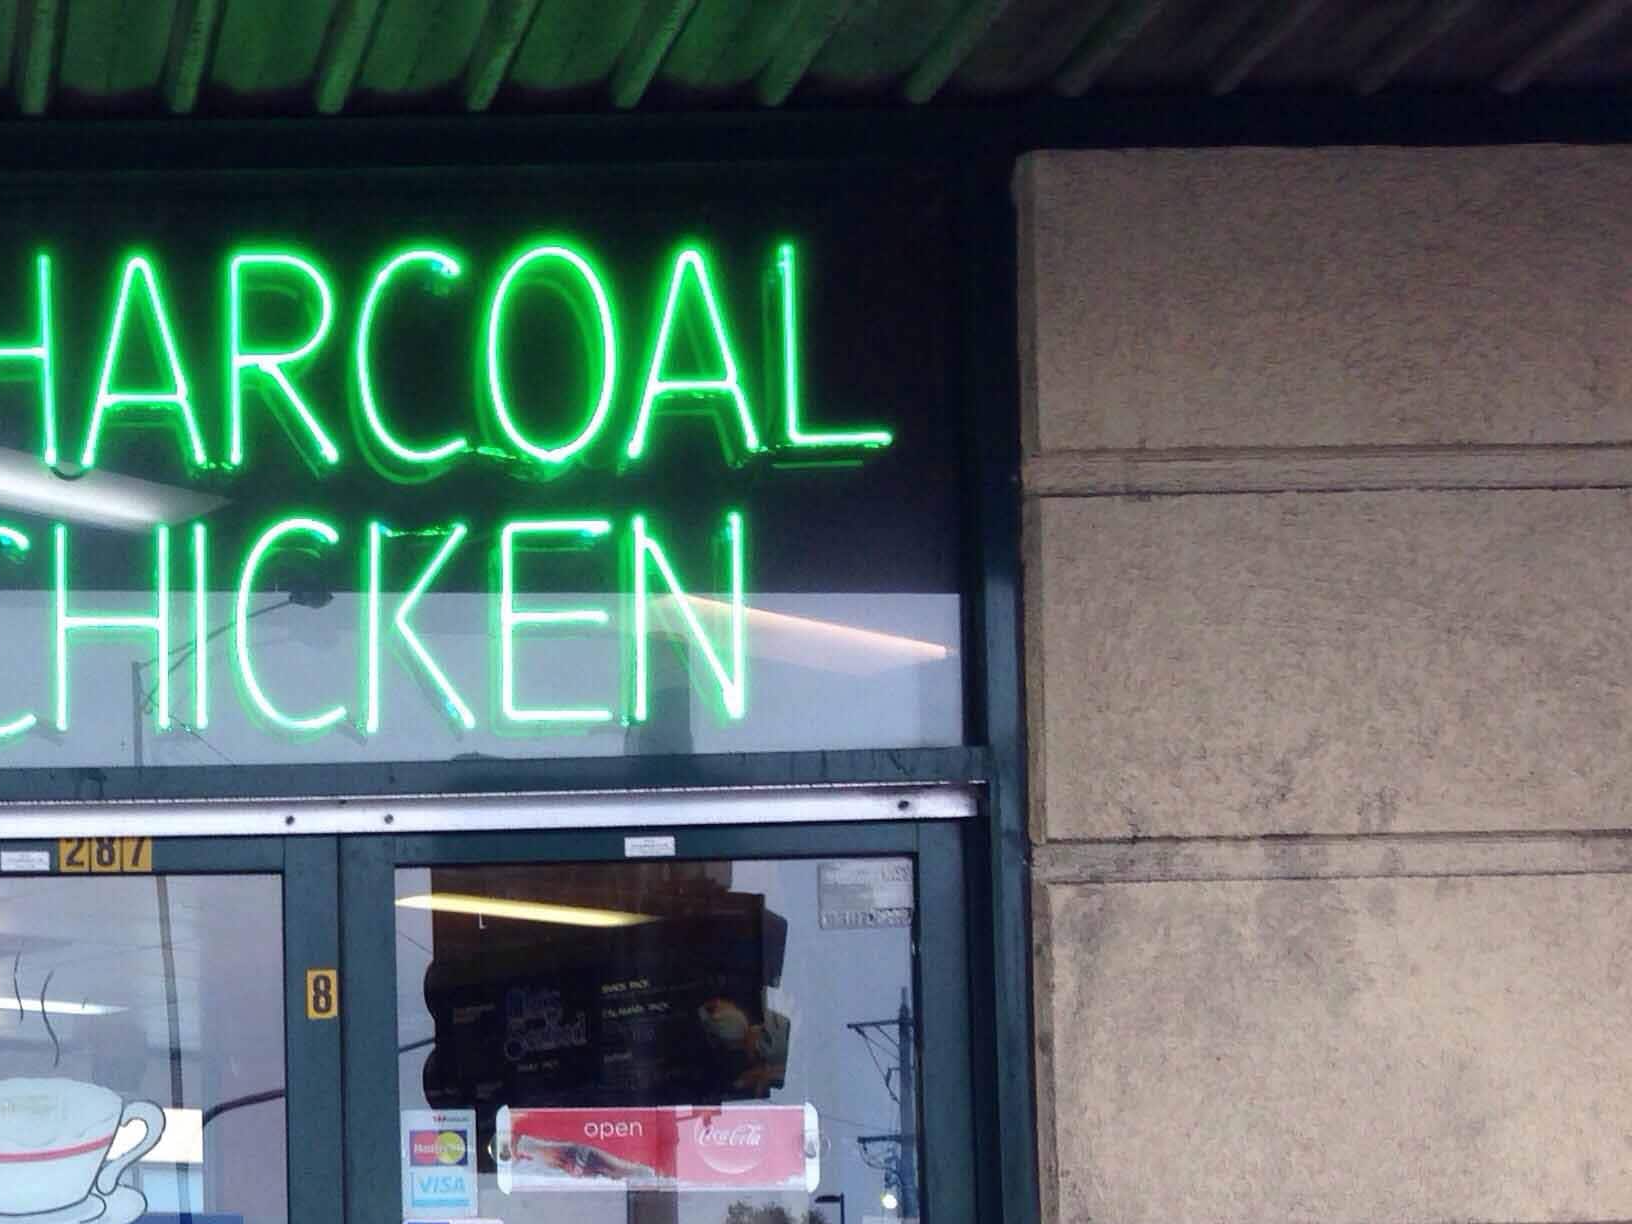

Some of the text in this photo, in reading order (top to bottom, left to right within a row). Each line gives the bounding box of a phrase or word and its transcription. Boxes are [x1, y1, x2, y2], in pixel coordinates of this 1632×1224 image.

[64, 837, 147, 867] 287
[311, 974, 333, 1014] 8
[583, 1120, 644, 1140] open
[419, 1175, 466, 1193] VISA
